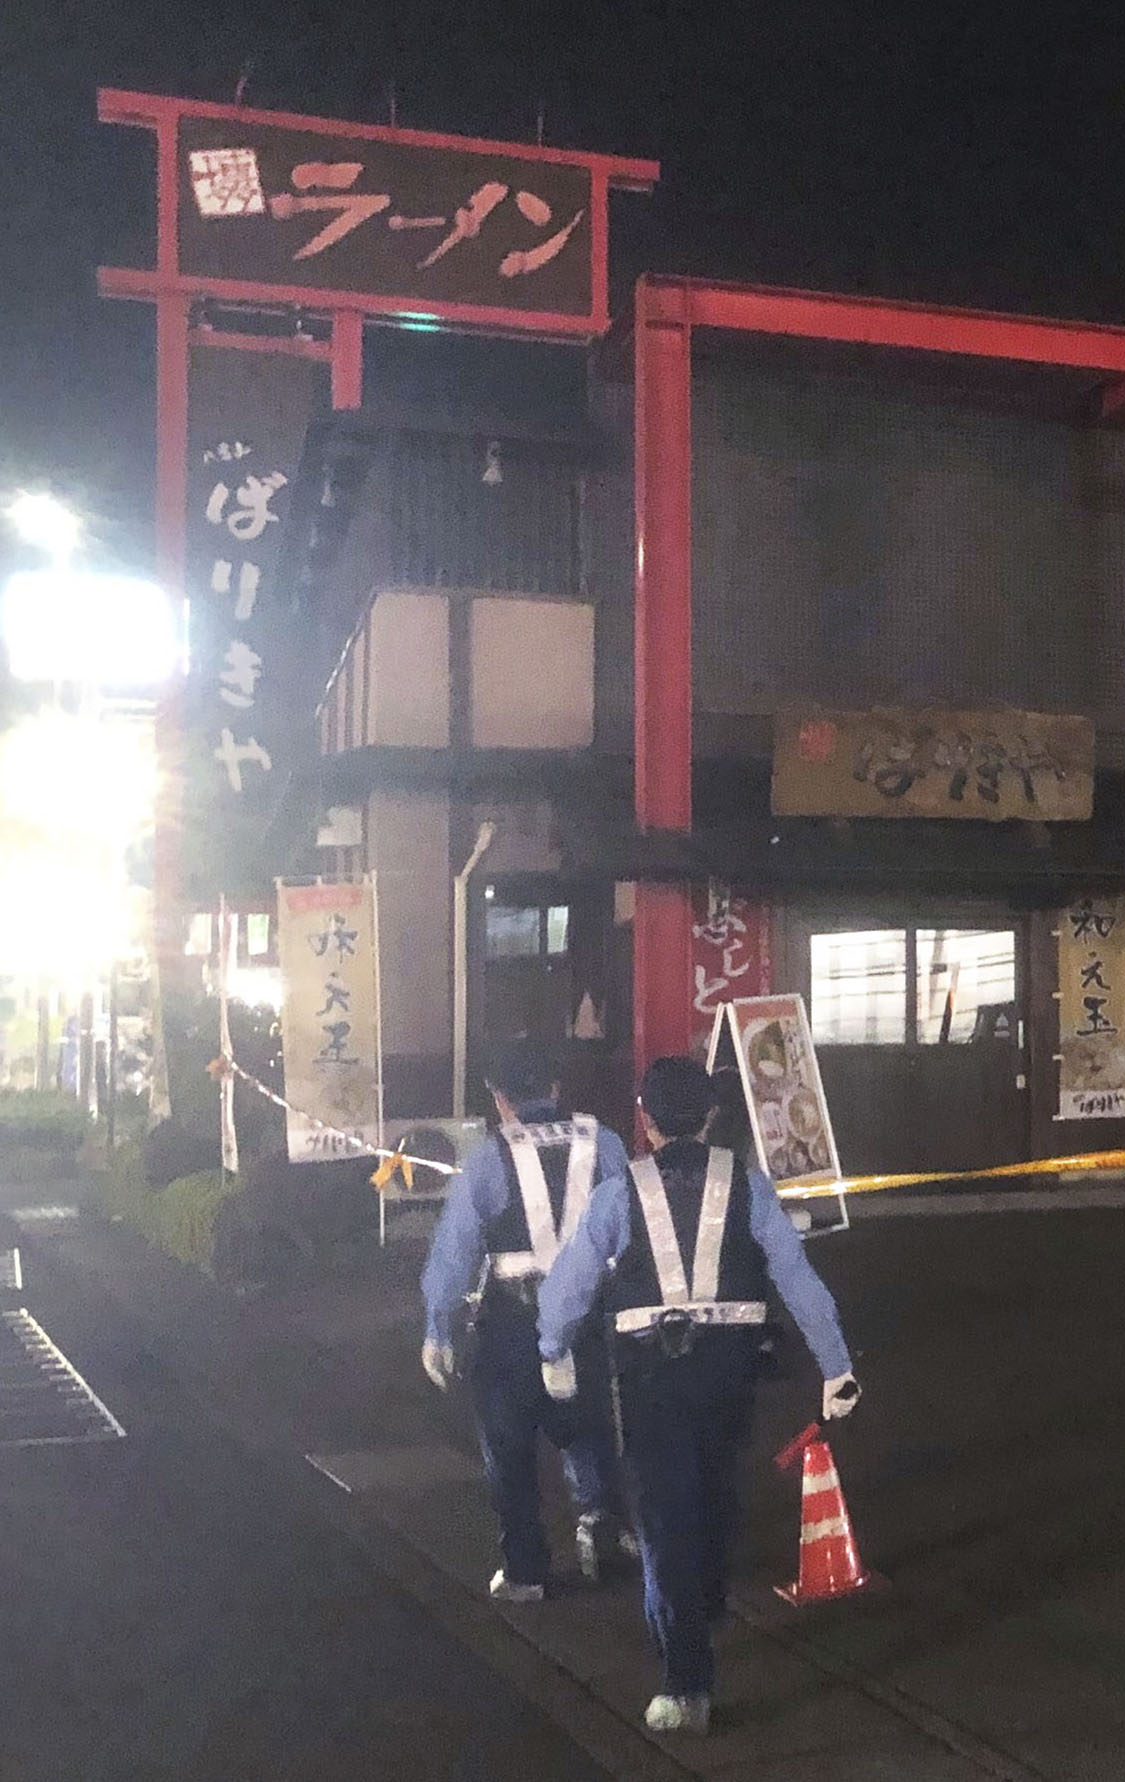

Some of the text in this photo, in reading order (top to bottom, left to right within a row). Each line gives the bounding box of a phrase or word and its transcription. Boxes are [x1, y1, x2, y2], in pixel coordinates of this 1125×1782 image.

[271, 161, 585, 277] ラーメン
[206, 471, 288, 793] ばりきや
[1069, 899, 1118, 1036] 和え玉
